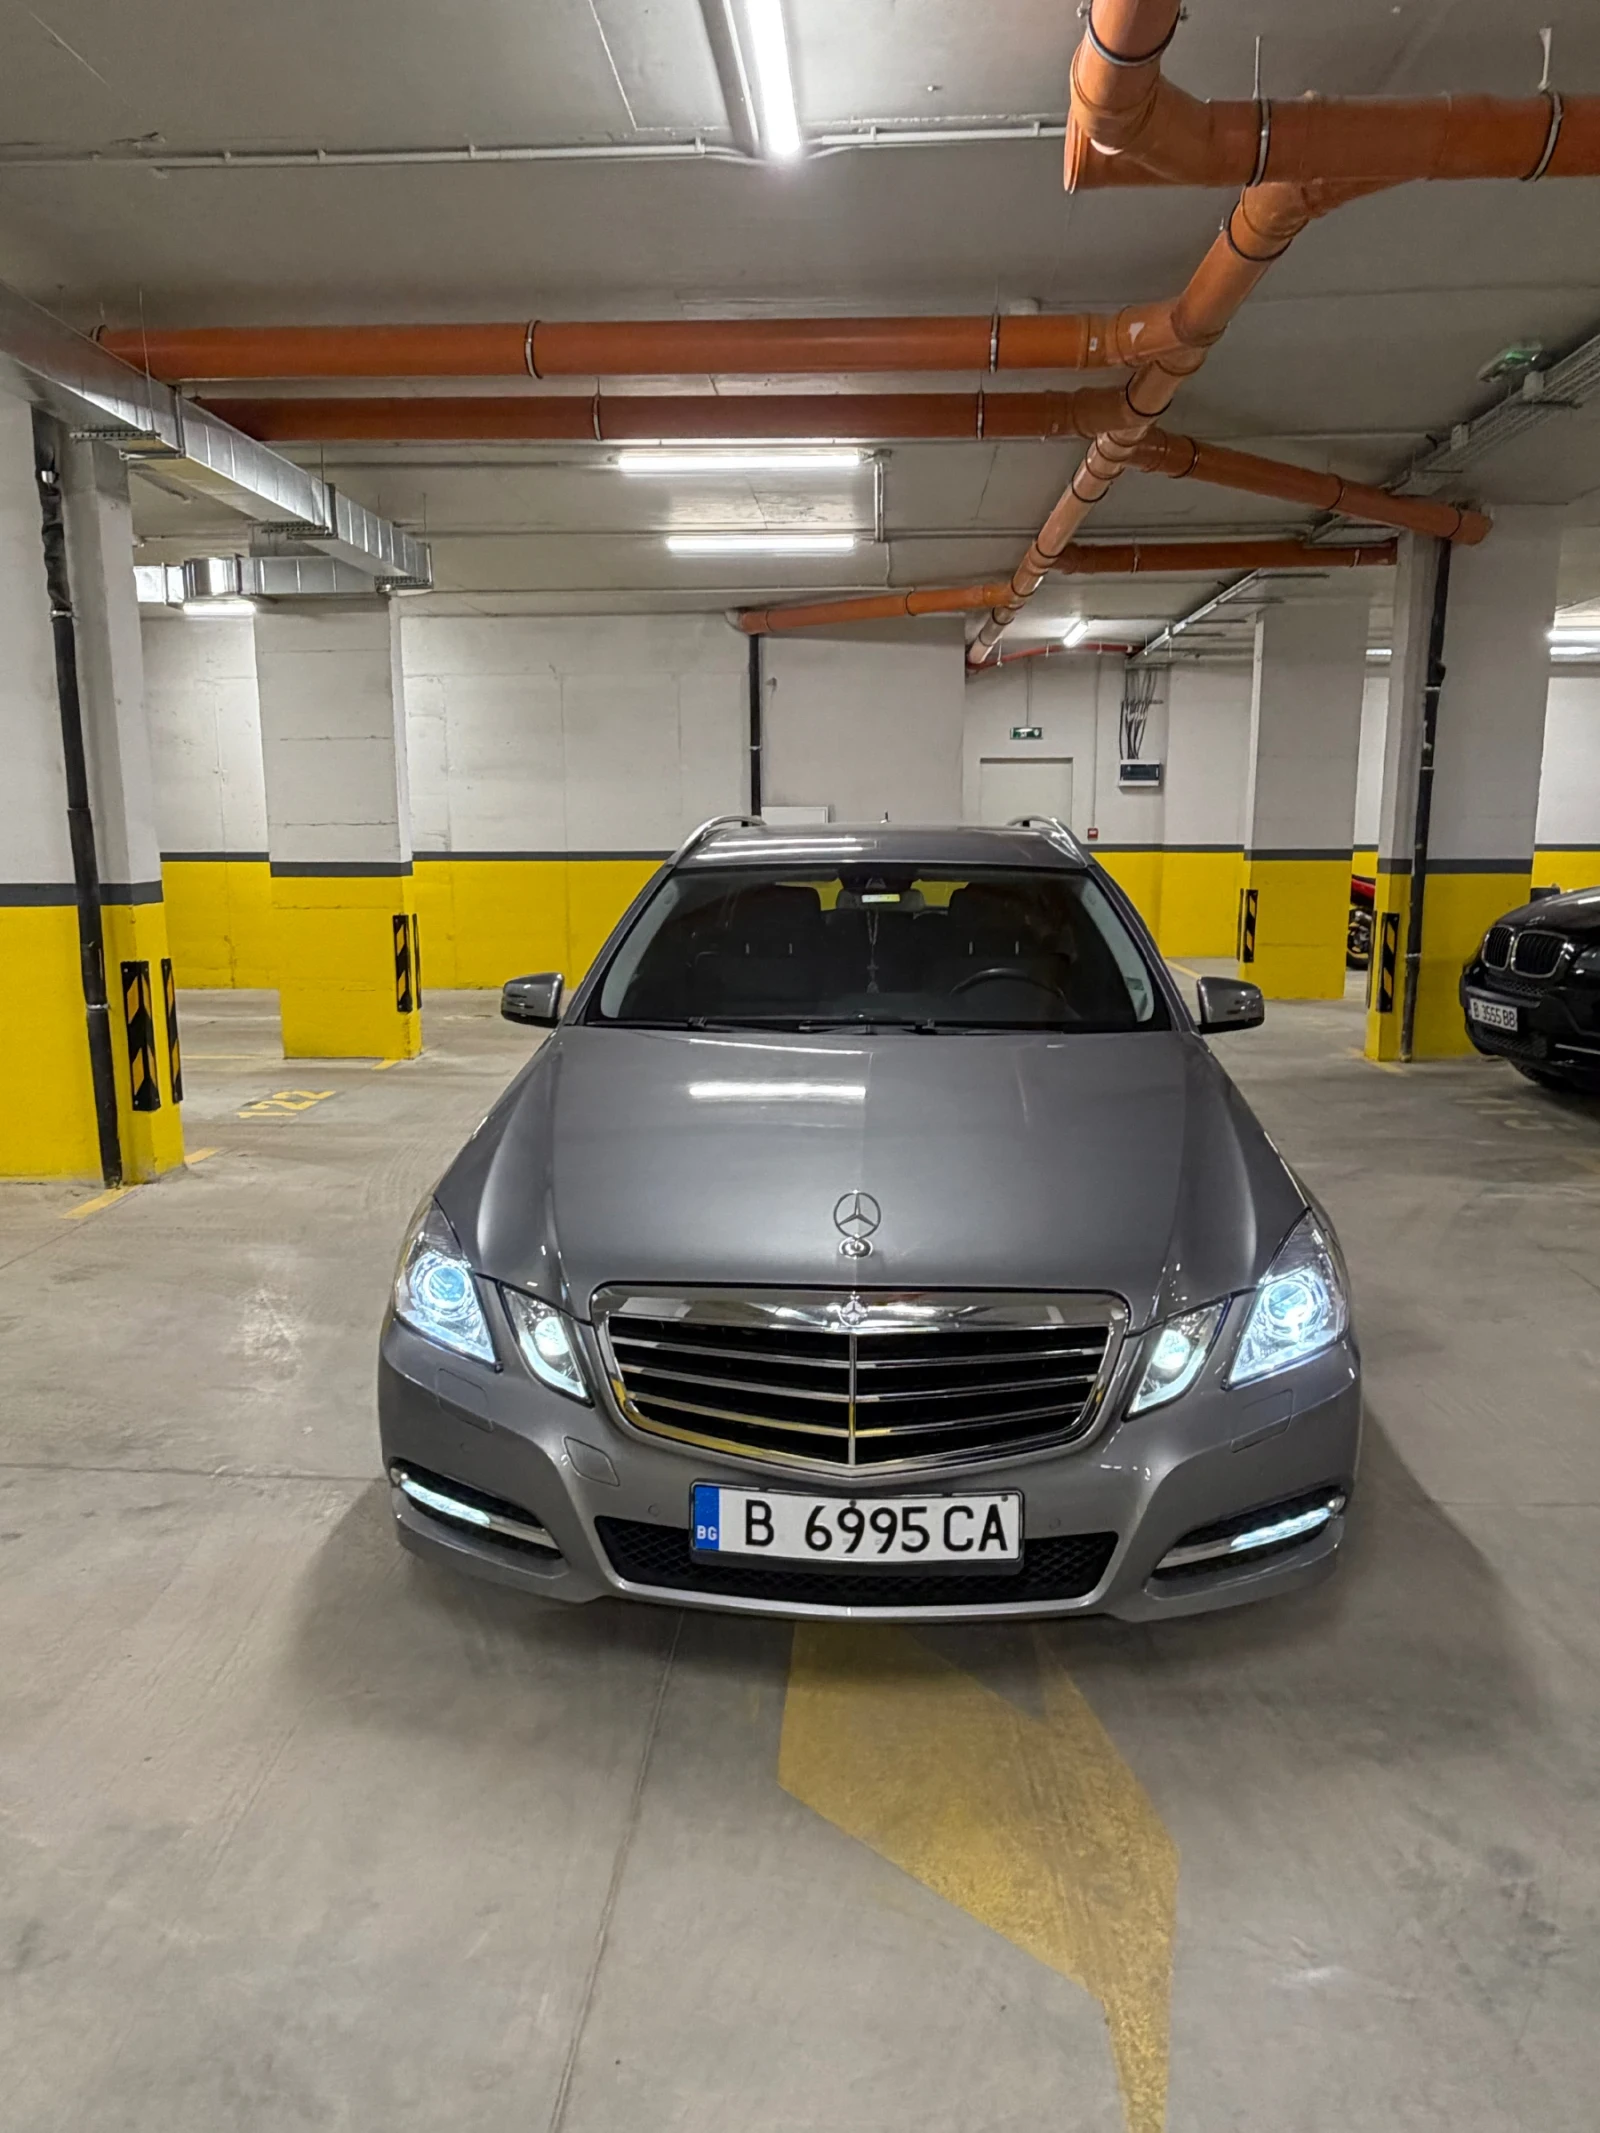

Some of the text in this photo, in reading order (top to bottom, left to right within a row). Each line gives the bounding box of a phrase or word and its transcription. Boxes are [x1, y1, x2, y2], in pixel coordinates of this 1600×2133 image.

[236, 1090, 336, 1118] 122
[696, 1499, 1008, 1554] BG B 6995 CA
